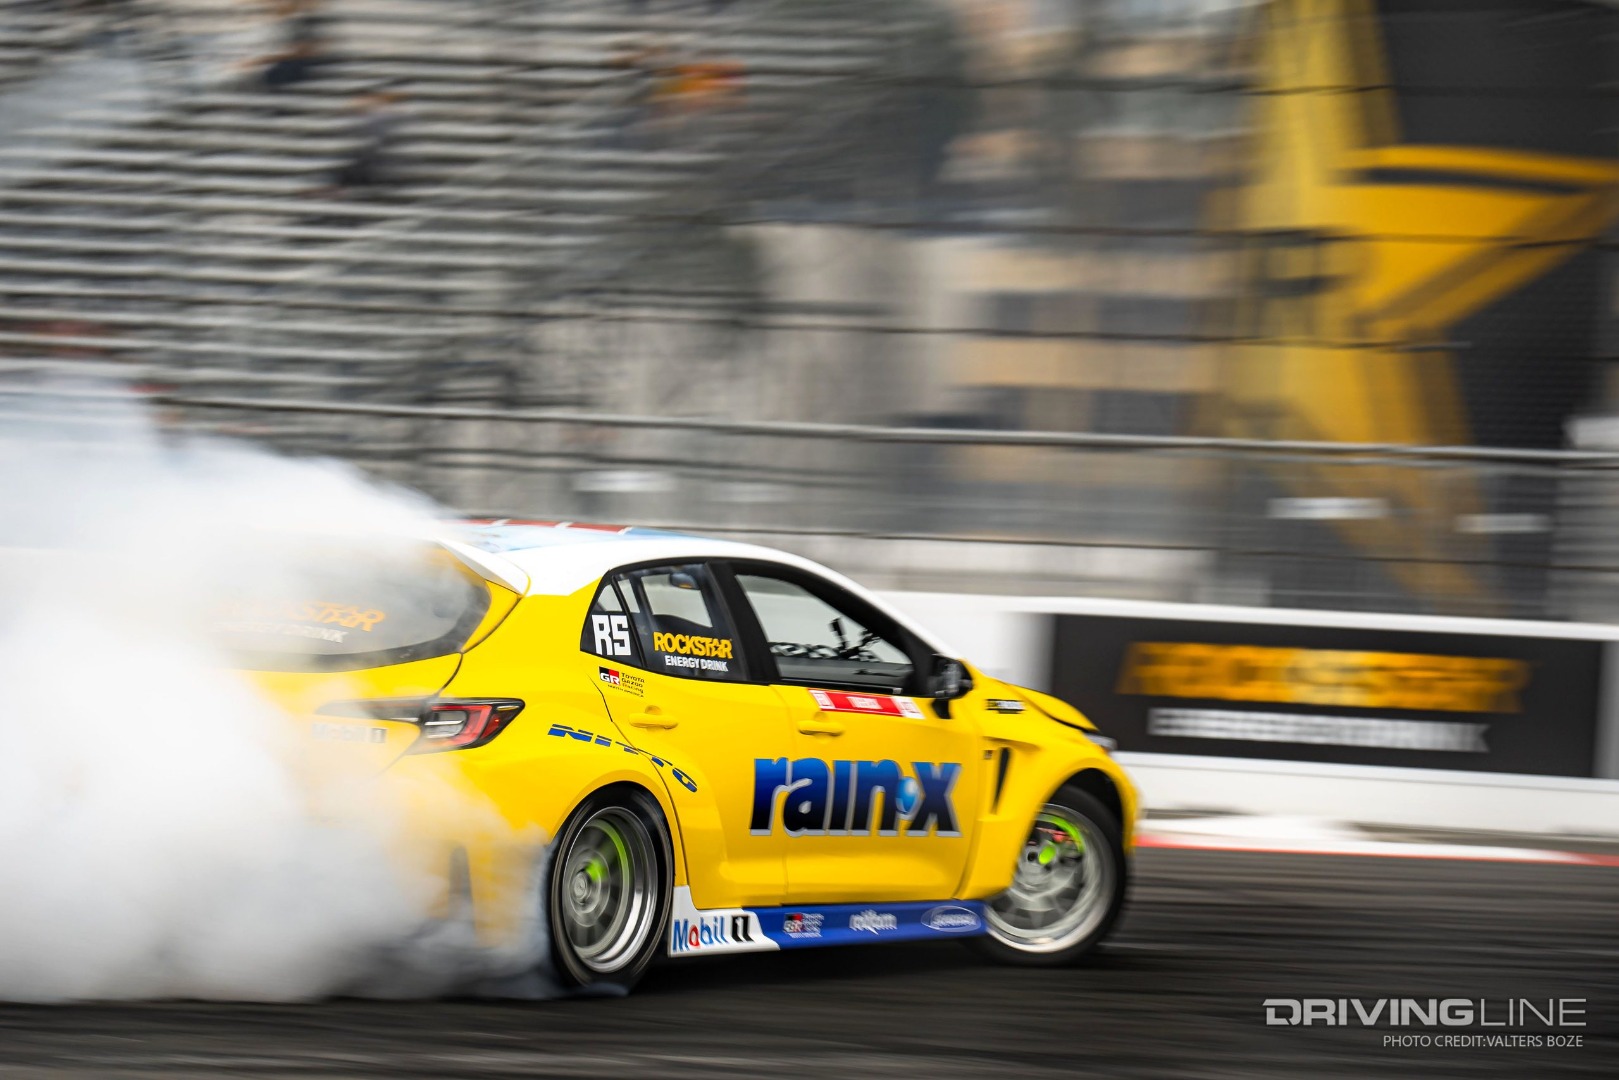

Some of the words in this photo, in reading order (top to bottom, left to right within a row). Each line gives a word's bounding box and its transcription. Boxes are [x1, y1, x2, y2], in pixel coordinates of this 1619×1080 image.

[592, 614, 631, 656] RS
[653, 631, 733, 659] ROCKSTAR
[664, 655, 700, 669] ENERGY
[700, 658, 729, 672] DRINK
[672, 915, 730, 952] Mobil
